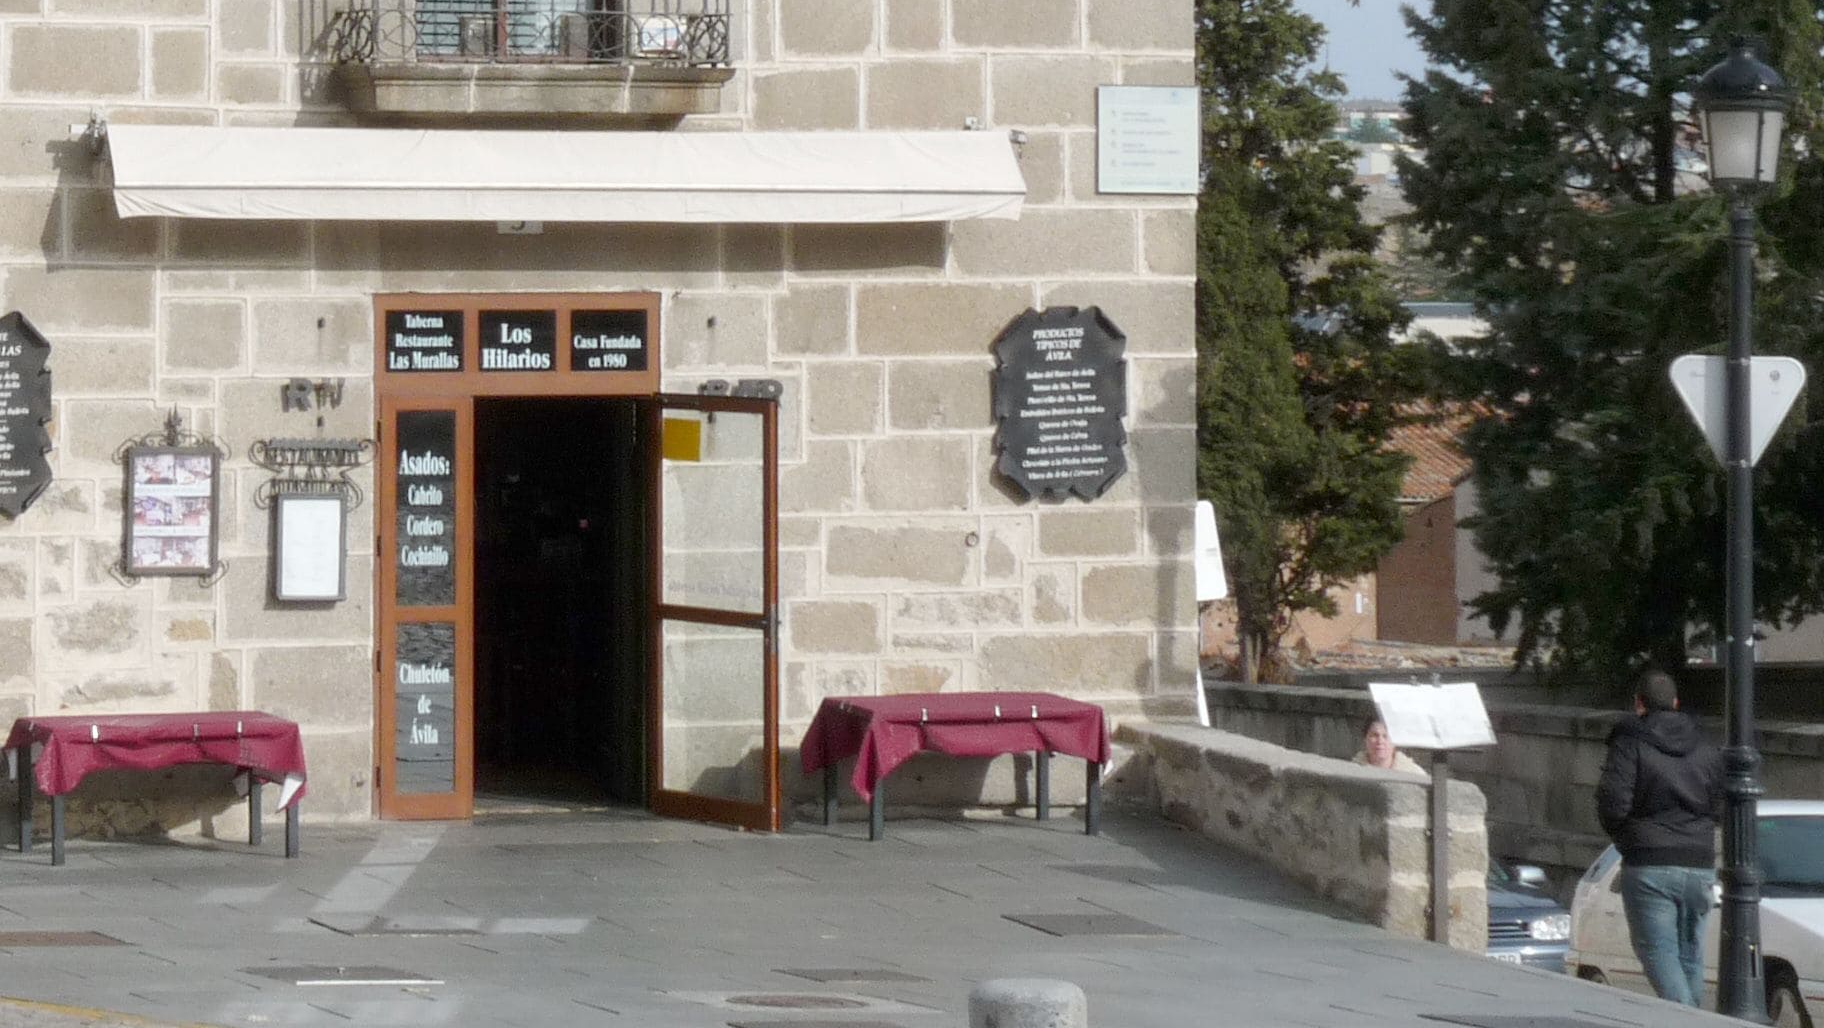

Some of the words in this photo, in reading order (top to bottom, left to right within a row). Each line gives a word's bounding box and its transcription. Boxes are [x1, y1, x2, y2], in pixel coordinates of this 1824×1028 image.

[405, 314, 444, 329] Taberna
[395, 333, 454, 348] Restaurante
[500, 323, 532, 343] Los
[573, 335, 598, 349] Casa
[600, 334, 642, 349] Fundada
[389, 351, 410, 370] Las
[412, 350, 460, 369] Murallas
[481, 349, 551, 370] Hilarios
[588, 355, 602, 368] en
[603, 354, 627, 368] 1980
[399, 449, 450, 475] Asados:
[407, 483, 443, 506] Cabrito
[406, 514, 444, 536] Cordero
[401, 545, 449, 567] Cochinillo
[399, 662, 450, 685] Chuletón
[417, 694, 432, 714] de
[409, 717, 439, 744] Ávila
